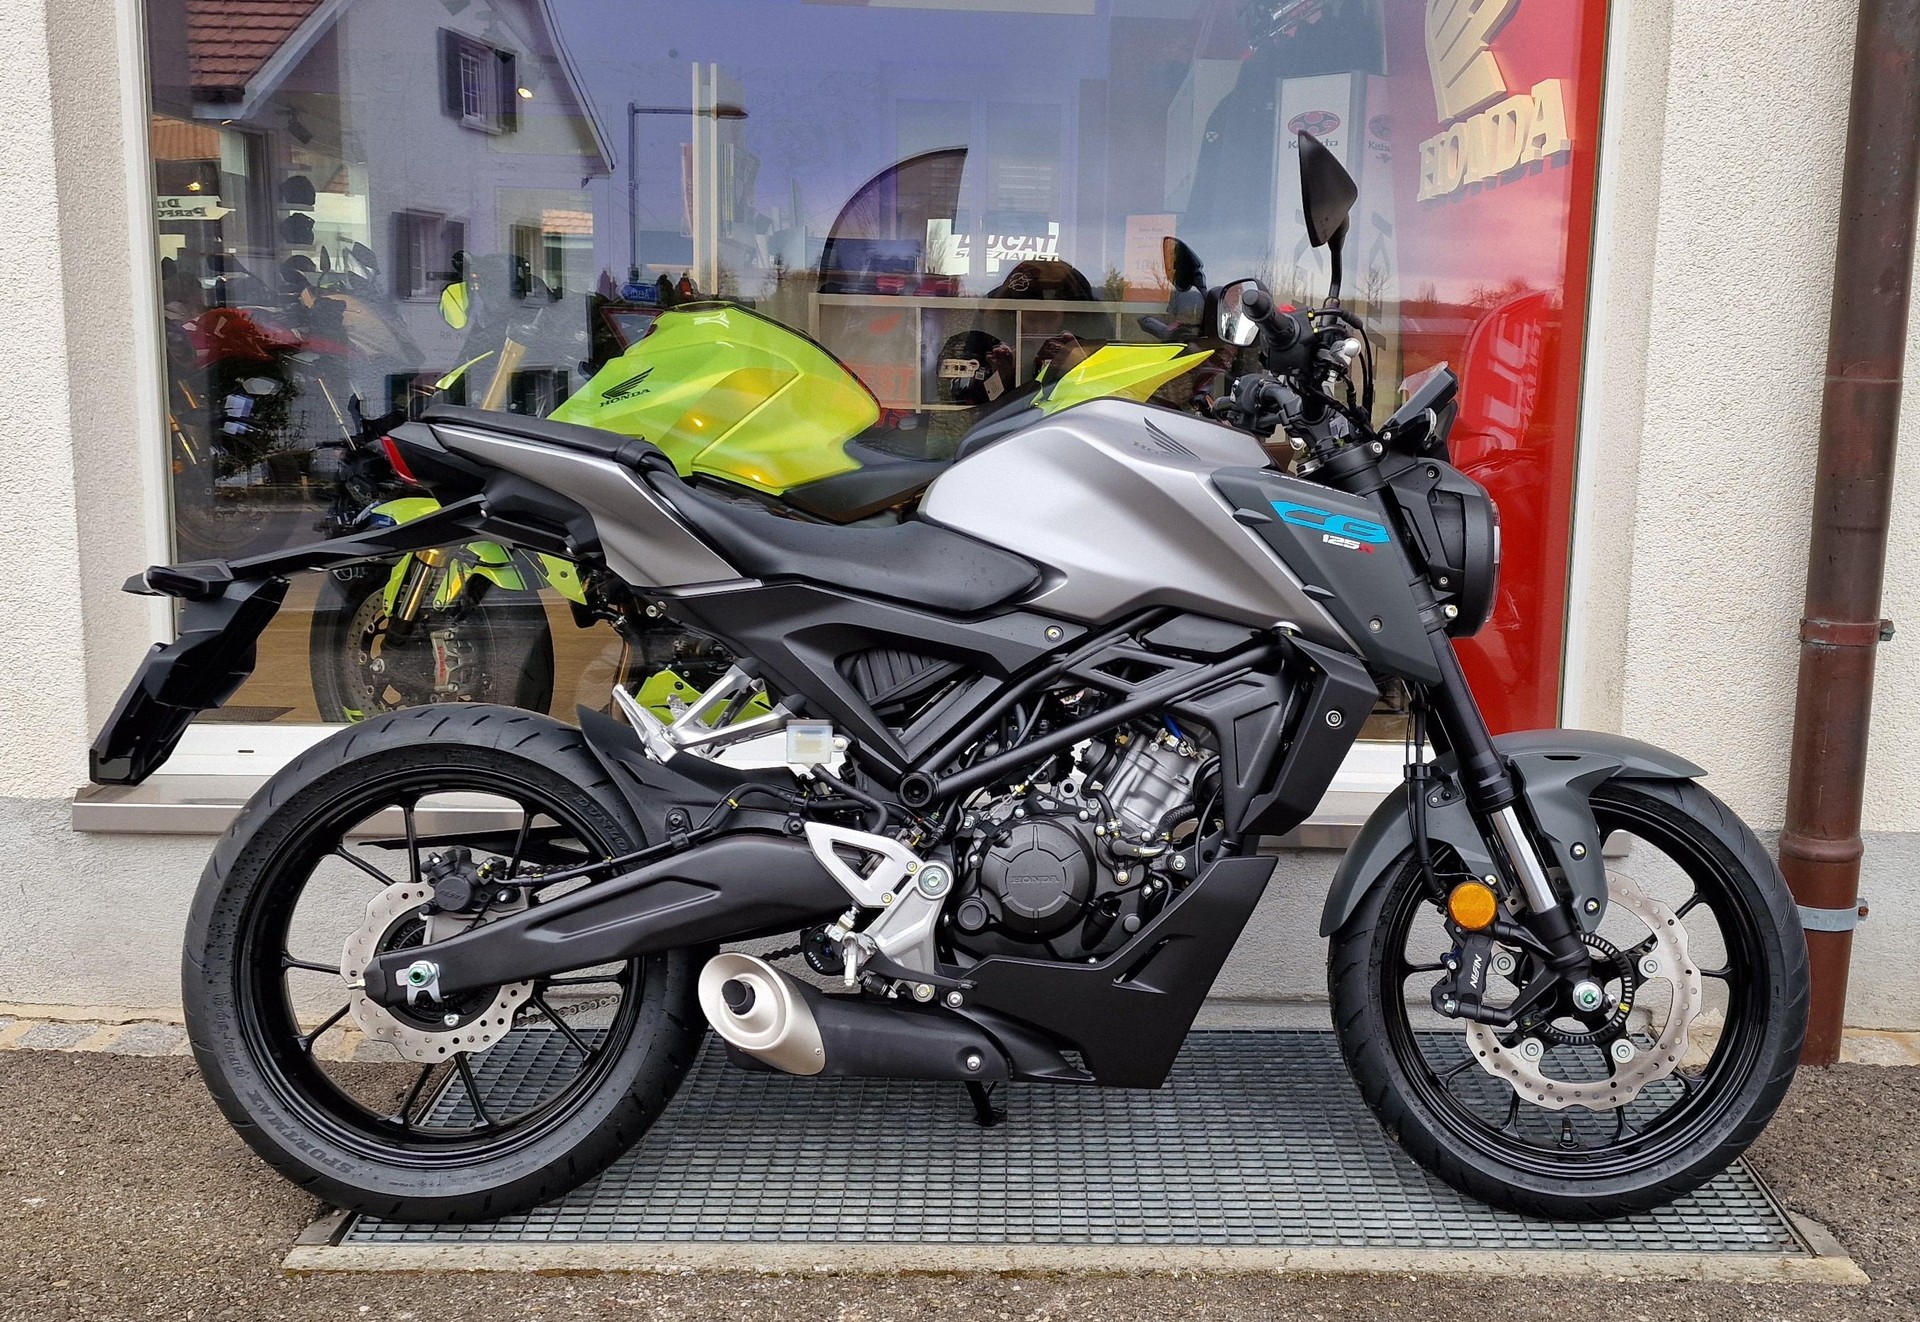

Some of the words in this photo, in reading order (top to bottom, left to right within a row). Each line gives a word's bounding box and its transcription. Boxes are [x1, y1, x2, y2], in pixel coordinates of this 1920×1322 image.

[1287, 138, 1339, 150] Kto
[1417, 79, 1571, 202] HONDA
[957, 234, 1060, 252] DUCAT
[954, 249, 1060, 262] SEZIALIST
[599, 388, 651, 408] HONDA
[1322, 533, 1376, 555] 125R
[573, 793, 632, 856] DUNLO
[1010, 874, 1061, 884] HONDA
[247, 1089, 357, 1175] SPORTMAX
